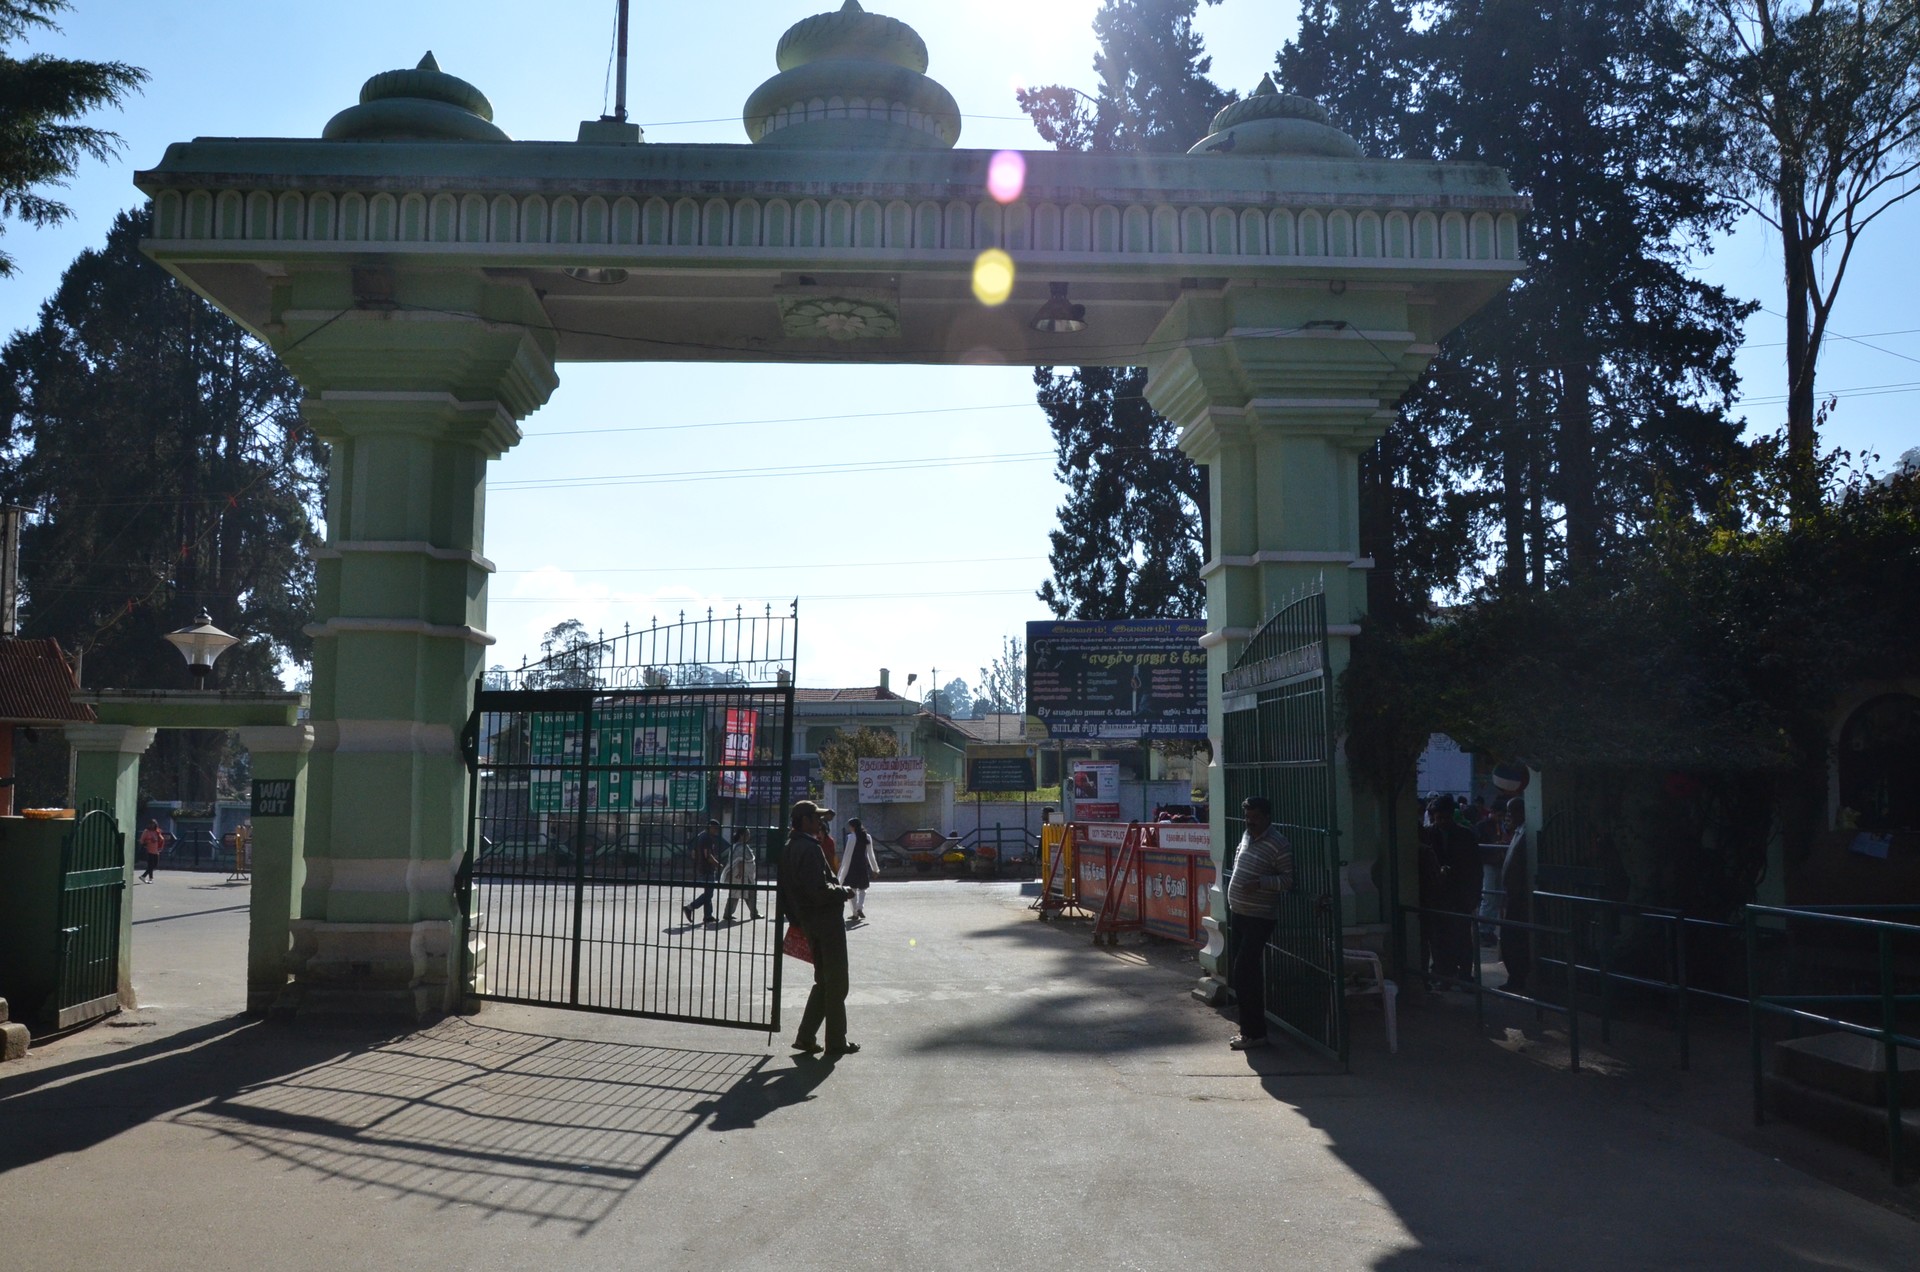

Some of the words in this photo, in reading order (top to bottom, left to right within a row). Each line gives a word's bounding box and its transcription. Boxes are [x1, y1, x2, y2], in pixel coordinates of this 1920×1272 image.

[1170, 652, 1180, 664] &
[1038, 706, 1050, 718] By
[259, 782, 290, 799] WAY
[259, 799, 287, 814] OUT
